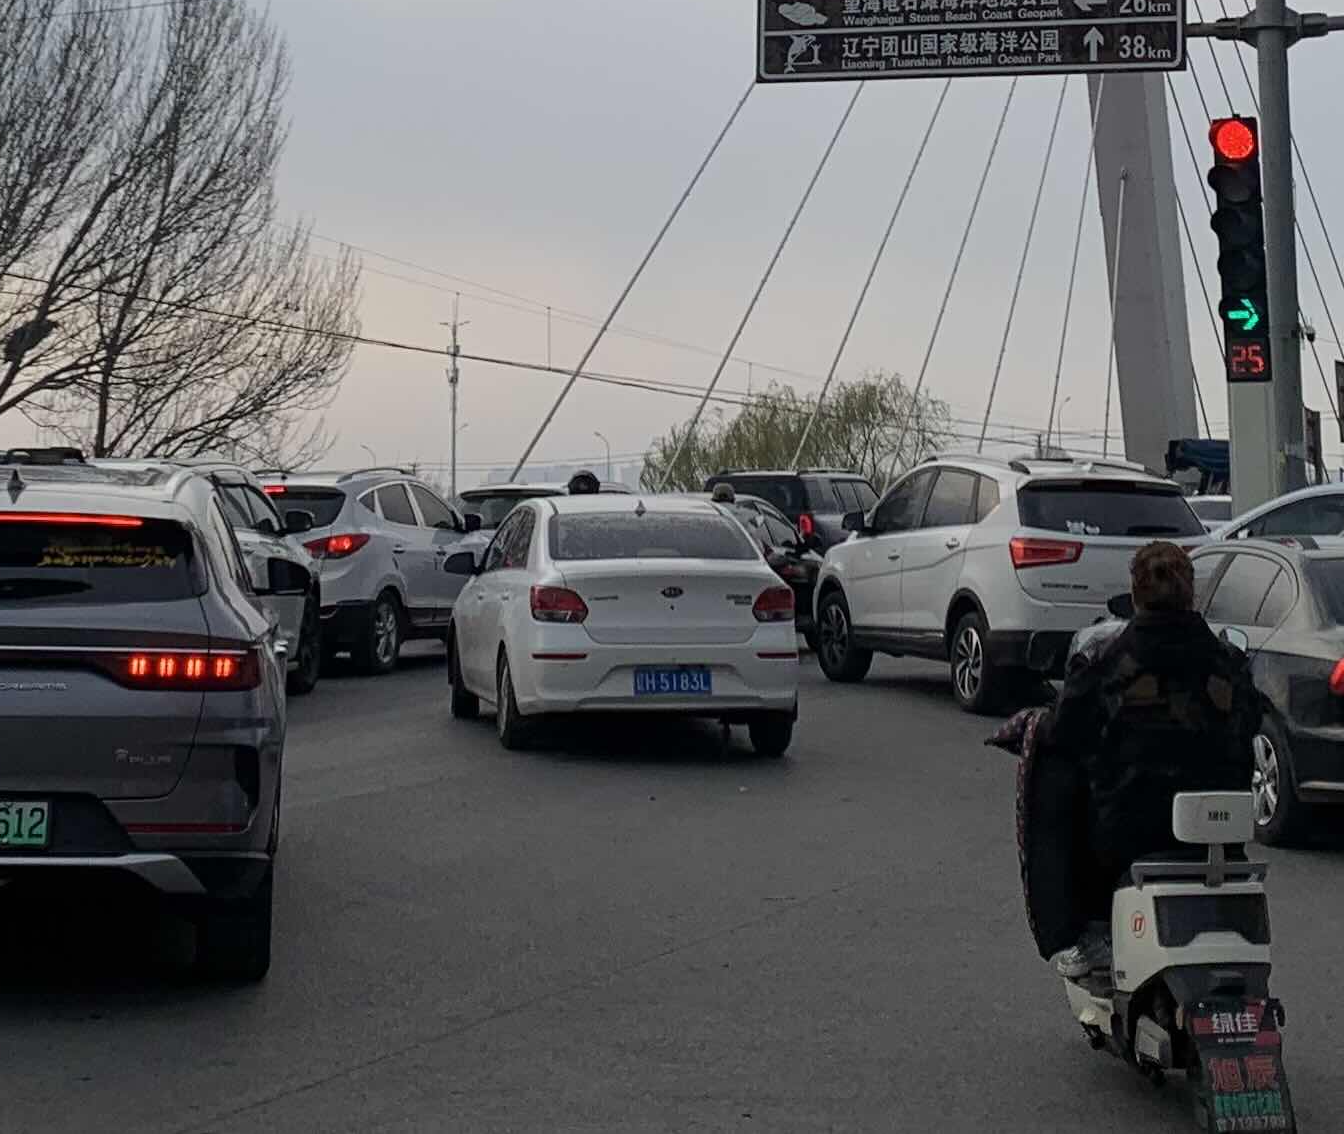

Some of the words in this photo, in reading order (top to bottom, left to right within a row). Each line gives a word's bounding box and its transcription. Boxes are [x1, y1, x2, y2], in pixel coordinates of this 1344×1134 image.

[909, 12, 940, 23] Stone
[945, 10, 976, 22] Beach
[982, 9, 1012, 20] Coast
[1018, 7, 1063, 20] Geopark
[842, 29, 1059, 59] 辽宁团山国家级海洋公园
[947, 54, 992, 66] National
[998, 53, 1032, 64] Ocean
[1038, 52, 1062, 63] Park
[1232, 345, 1264, 373] 25
